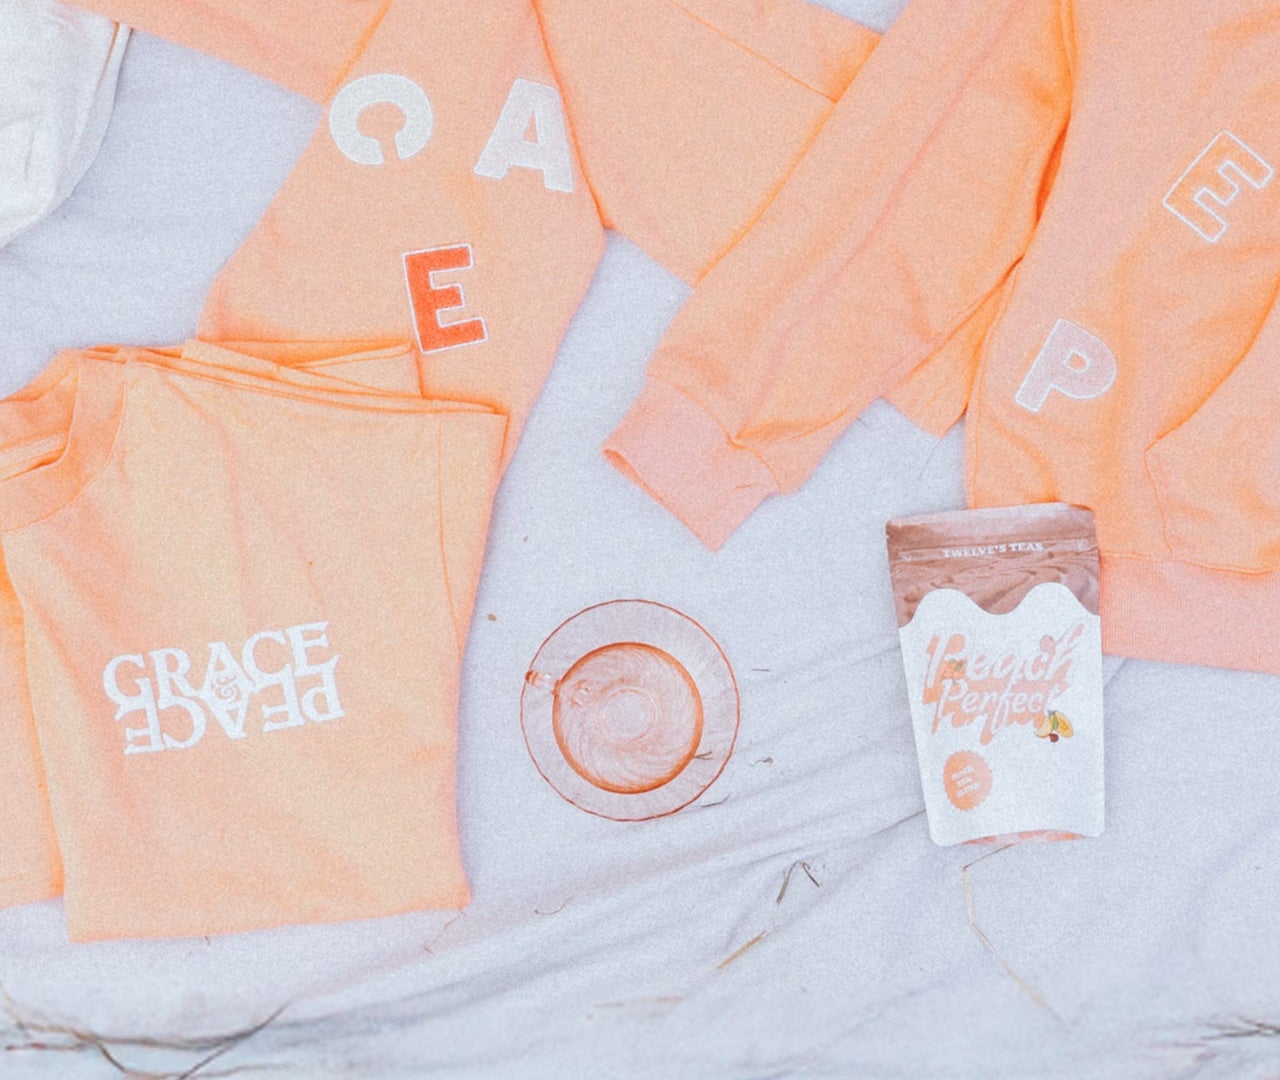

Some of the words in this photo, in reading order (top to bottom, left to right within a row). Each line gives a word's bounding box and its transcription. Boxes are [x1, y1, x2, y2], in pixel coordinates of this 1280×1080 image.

[329, 73, 434, 165] C
[473, 78, 574, 193] A
[1163, 130, 1274, 242] E
[401, 243, 488, 353] E
[1015, 318, 1117, 413] P
[942, 544, 1007, 559] TWELVE'S
[1008, 542, 1044, 553] TEAS
[102, 621, 329, 710] GRACE
[114, 654, 347, 756] PEACE
[212, 672, 237, 704] &
[936, 677, 1073, 735] Perfect
